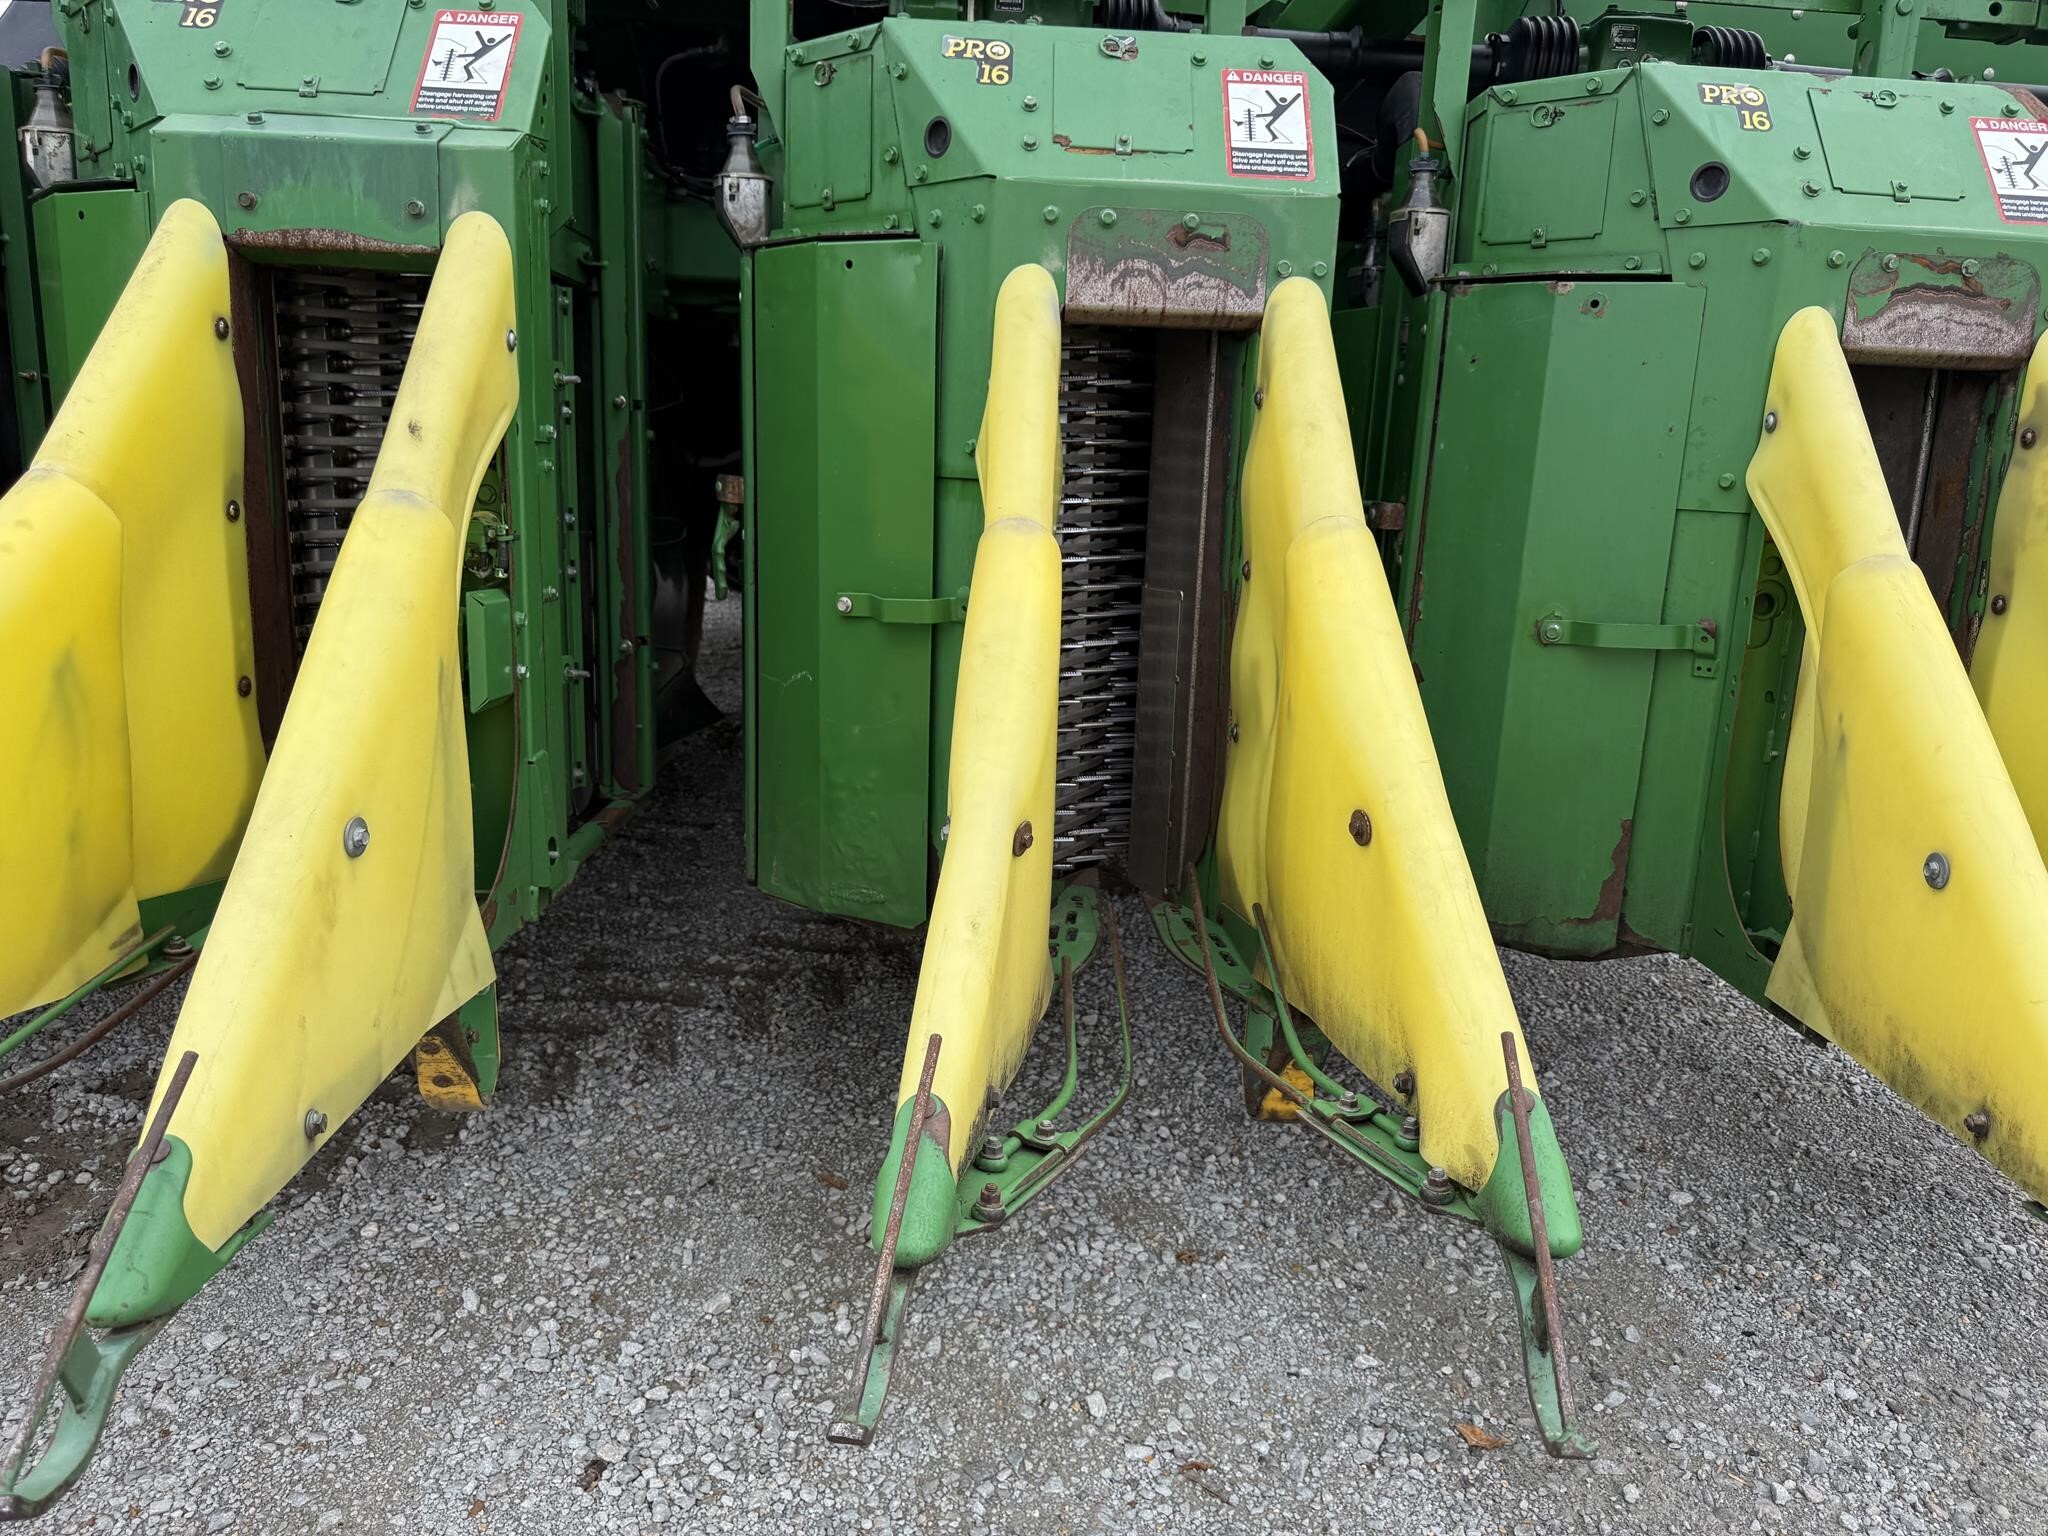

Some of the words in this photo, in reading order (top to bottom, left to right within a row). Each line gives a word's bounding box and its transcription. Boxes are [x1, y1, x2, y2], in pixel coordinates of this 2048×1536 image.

[182, 7, 216, 28] 16
[456, 13, 519, 25] DANGER
[945, 38, 1011, 60] PRO
[980, 63, 1010, 85] 16
[1242, 72, 1303, 84] DANGER
[419, 90, 452, 98] Disengage
[452, 92, 485, 100] harvesting
[1702, 84, 1764, 106] PRO
[435, 104, 468, 112] unclogging
[1741, 110, 1771, 131] 16
[1989, 120, 2048, 131] DANGER
[1232, 150, 1263, 158] Disengage
[1263, 152, 1294, 160] harvesting
